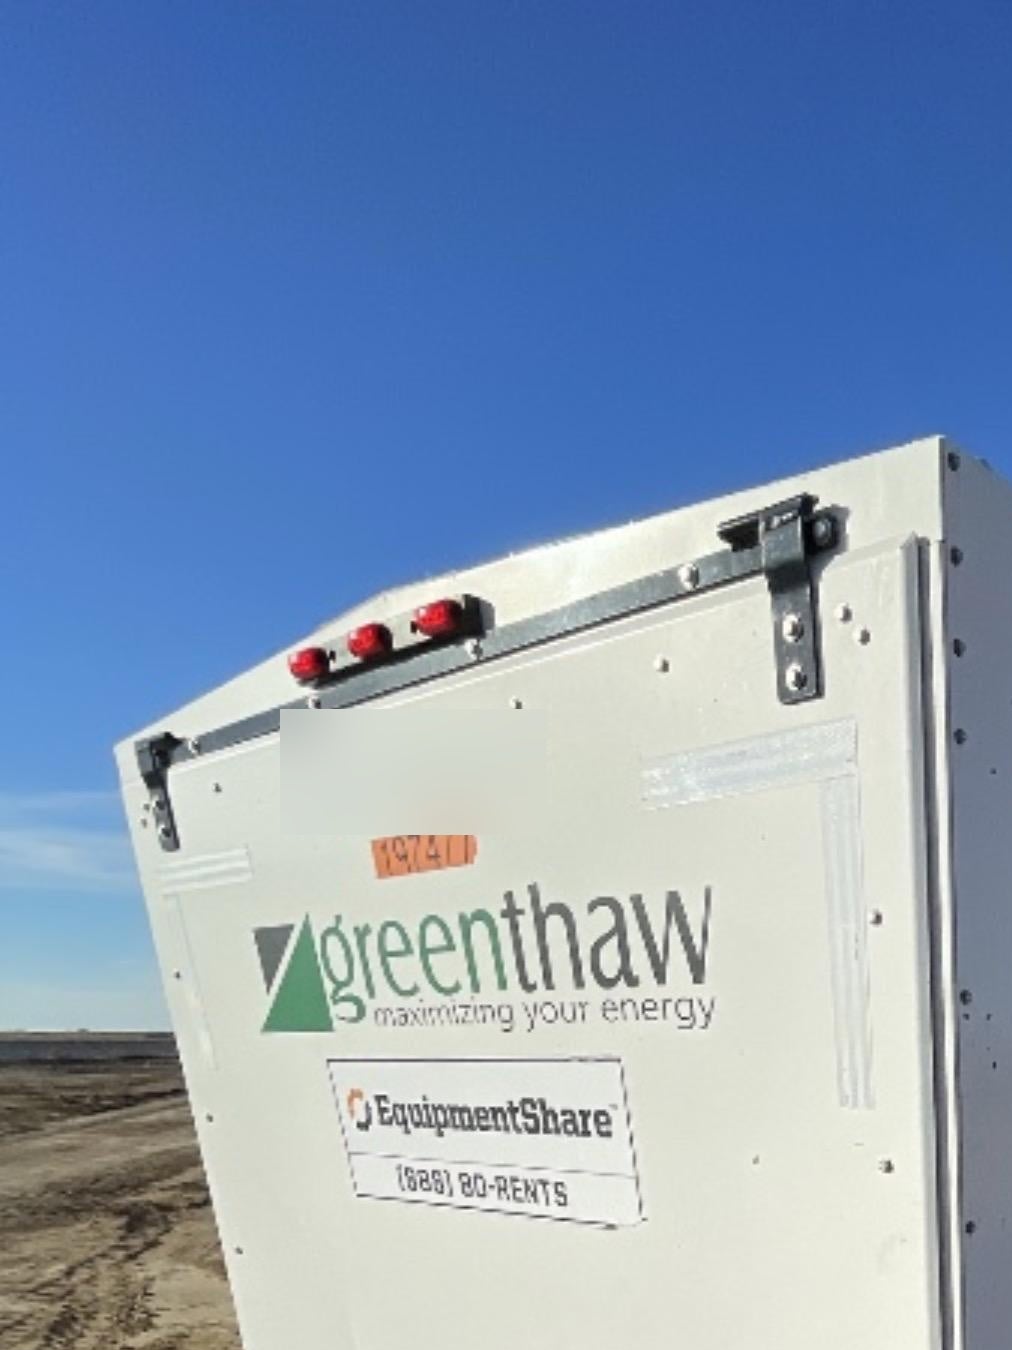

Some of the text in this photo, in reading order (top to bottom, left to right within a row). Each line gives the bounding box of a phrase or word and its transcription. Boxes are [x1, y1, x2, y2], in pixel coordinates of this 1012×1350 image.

[319, 882, 712, 1024] greenthaw
[373, 995, 716, 1033] maximizing your energy
[374, 1094, 614, 1138] EquipmentShare
